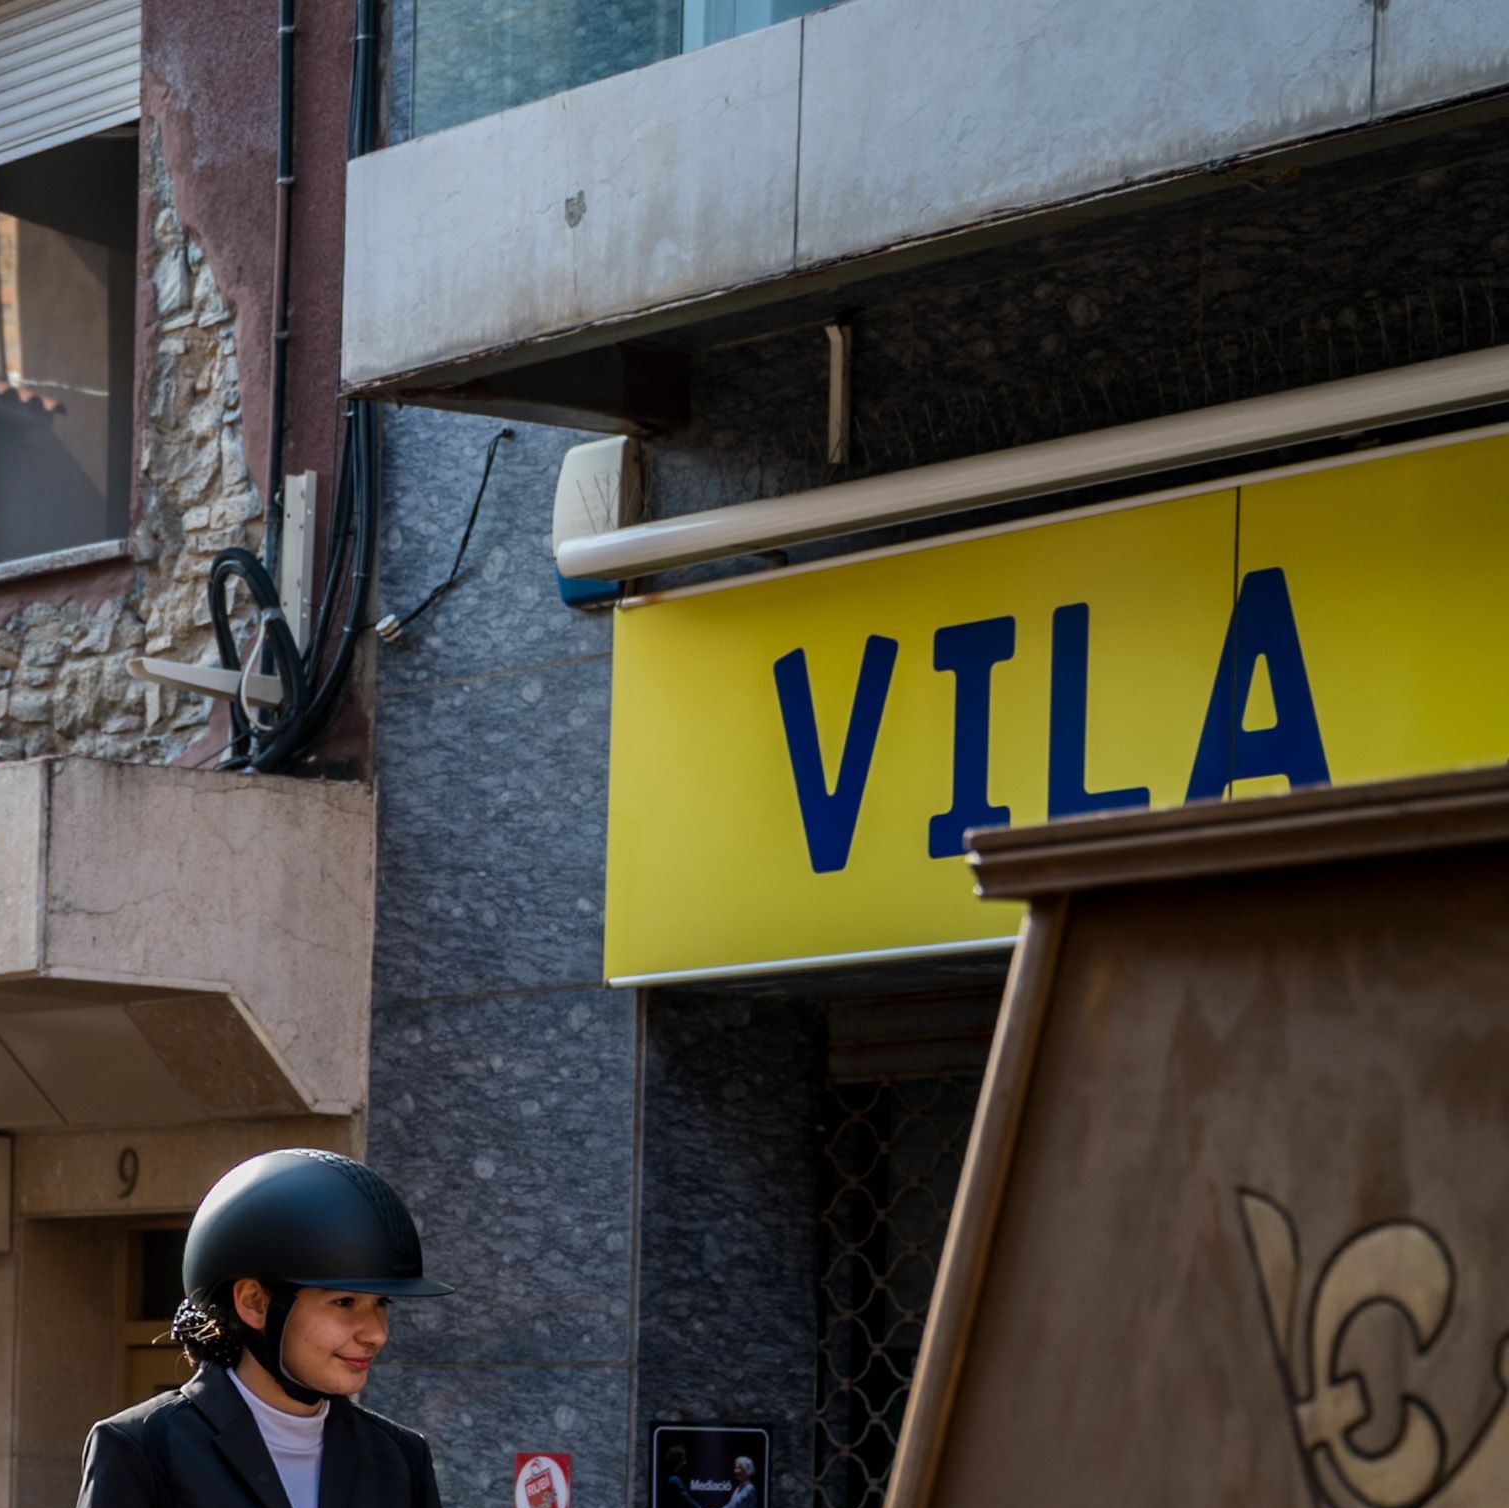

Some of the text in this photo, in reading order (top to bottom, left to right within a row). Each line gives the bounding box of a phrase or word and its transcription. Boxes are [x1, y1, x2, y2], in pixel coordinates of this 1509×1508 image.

[773, 567, 1330, 873] VILA
[118, 1148, 139, 1199] 9
[690, 1480, 732, 1491] Mediació
